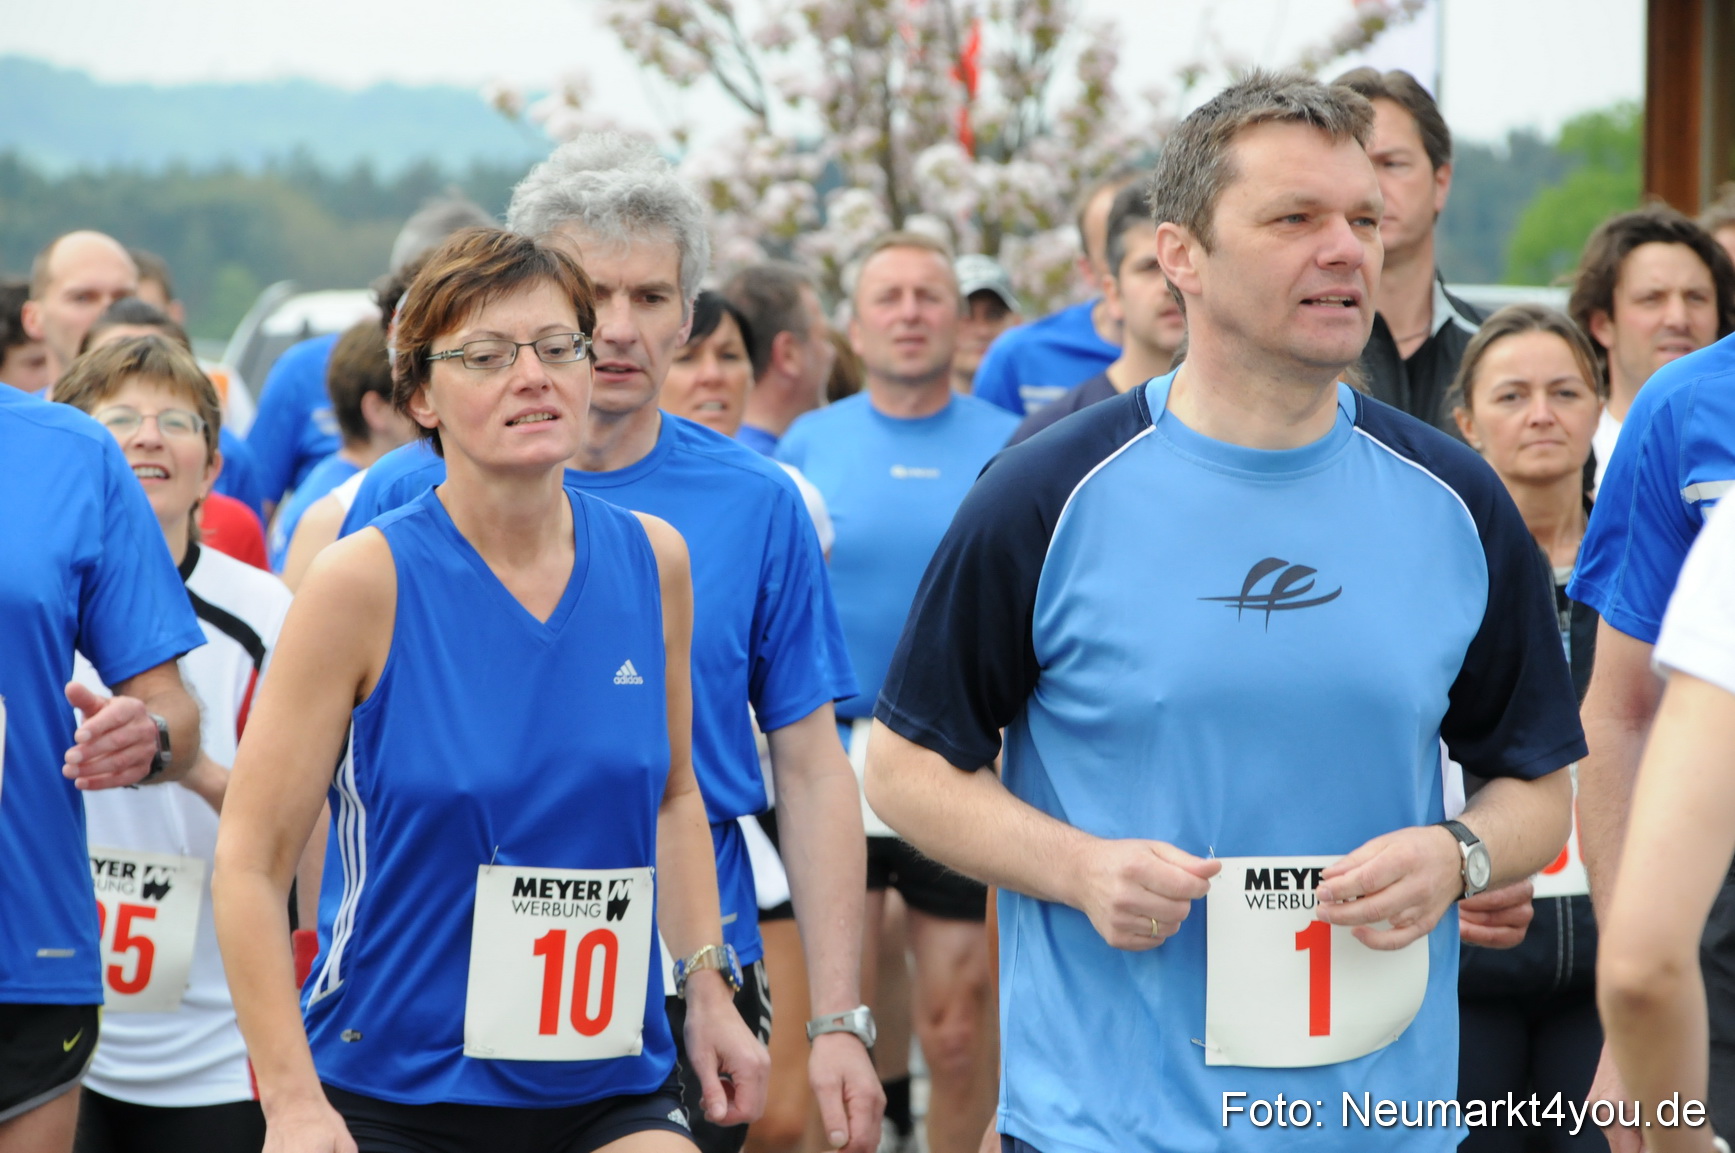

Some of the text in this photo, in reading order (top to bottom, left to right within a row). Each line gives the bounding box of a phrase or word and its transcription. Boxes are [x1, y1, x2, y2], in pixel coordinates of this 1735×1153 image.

[613, 675, 644, 685] adidas
[90, 857, 136, 879] YER
[512, 877, 603, 900] MEYER
[1244, 868, 1326, 891] MEYE
[512, 900, 602, 918] WERBUNG
[1244, 893, 1320, 910] WERBU
[533, 928, 619, 1037] 10
[1295, 920, 1331, 1037] 1
